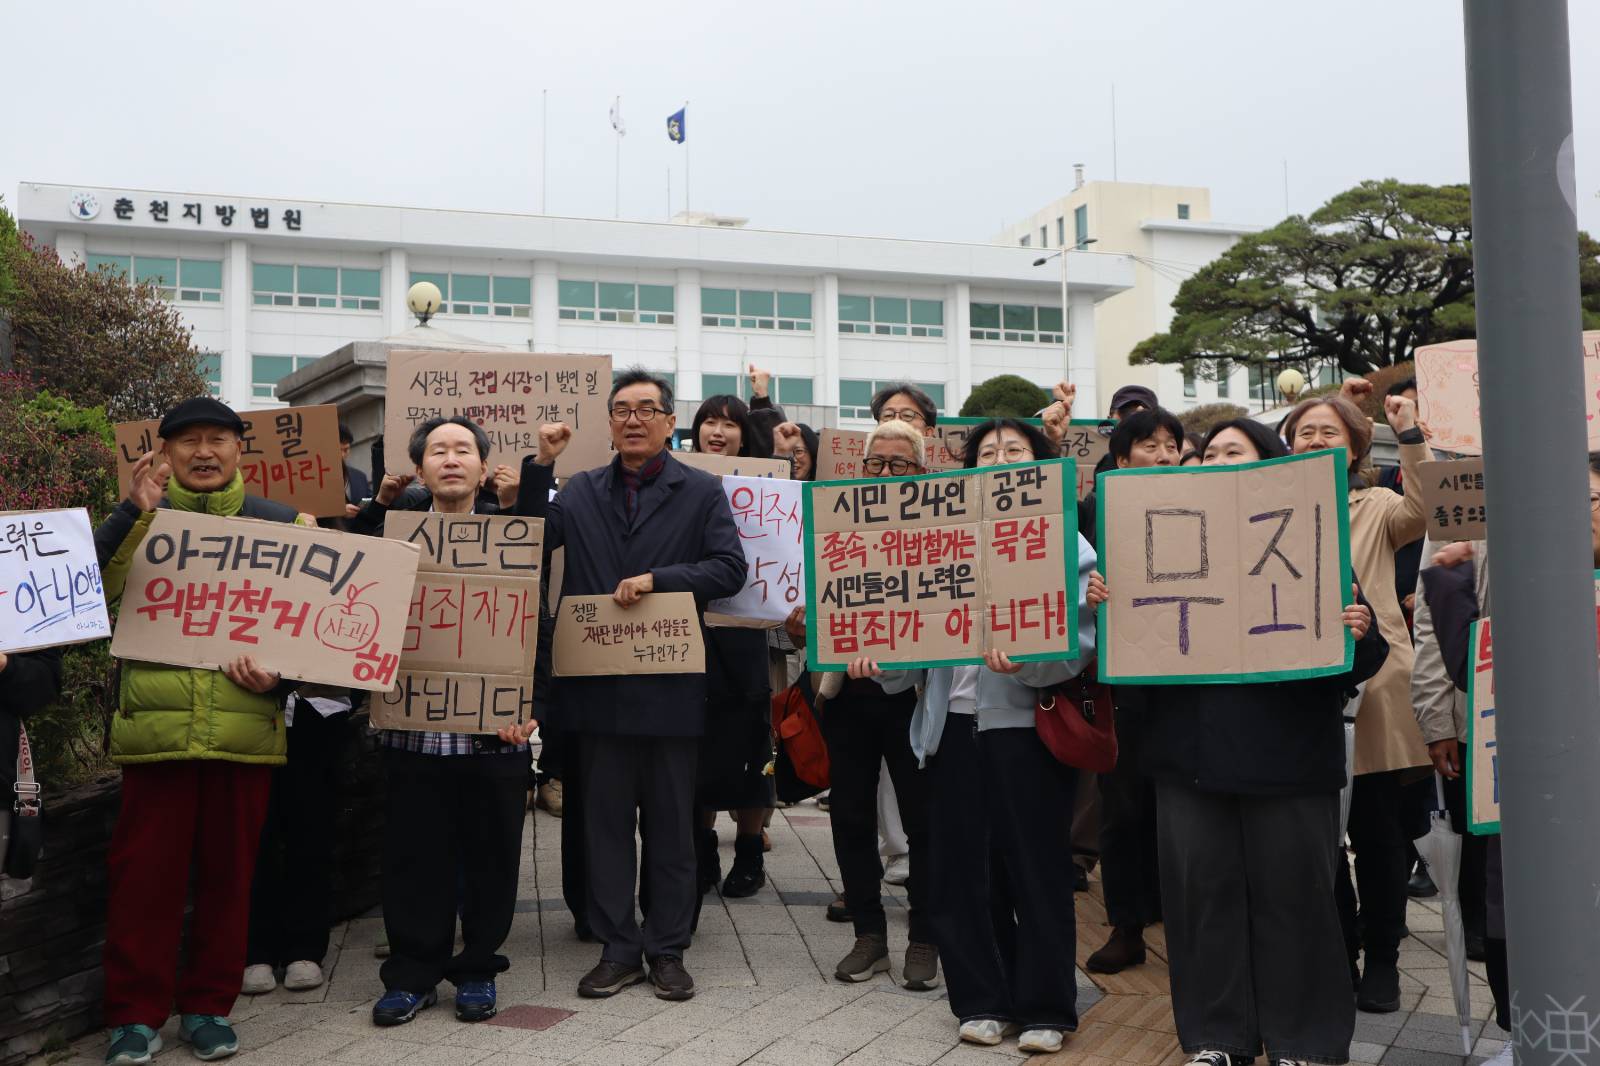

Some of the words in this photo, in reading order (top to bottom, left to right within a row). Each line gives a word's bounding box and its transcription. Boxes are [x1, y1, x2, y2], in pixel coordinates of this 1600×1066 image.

[113, 197, 302, 231] 춘천지방법원
[409, 370, 462, 398] 시장님,
[468, 370, 498, 395] 전임
[501, 370, 549, 394] 시장이
[556, 370, 579, 394] 벌인
[585, 371, 599, 395] 일
[275, 412, 309, 458] 뭘
[833, 484, 889, 523] 시민
[899, 479, 966, 520] 24인
[991, 466, 1047, 512] 공판
[145, 529, 366, 595] 아카데미
[408, 517, 540, 570] 시민은
[991, 517, 1049, 562] 묵살
[821, 570, 909, 608] 시민들의
[916, 563, 976, 600] 노력은
[1132, 503, 1322, 655] 무죄
[136, 577, 312, 645] 위법철거
[323, 615, 371, 643] 사과
[570, 603, 599, 623] 정말
[651, 618, 692, 638] 사람들은
[829, 608, 924, 653] 범죄가
[352, 642, 399, 685] 해
[383, 675, 532, 730] 아닙니다
